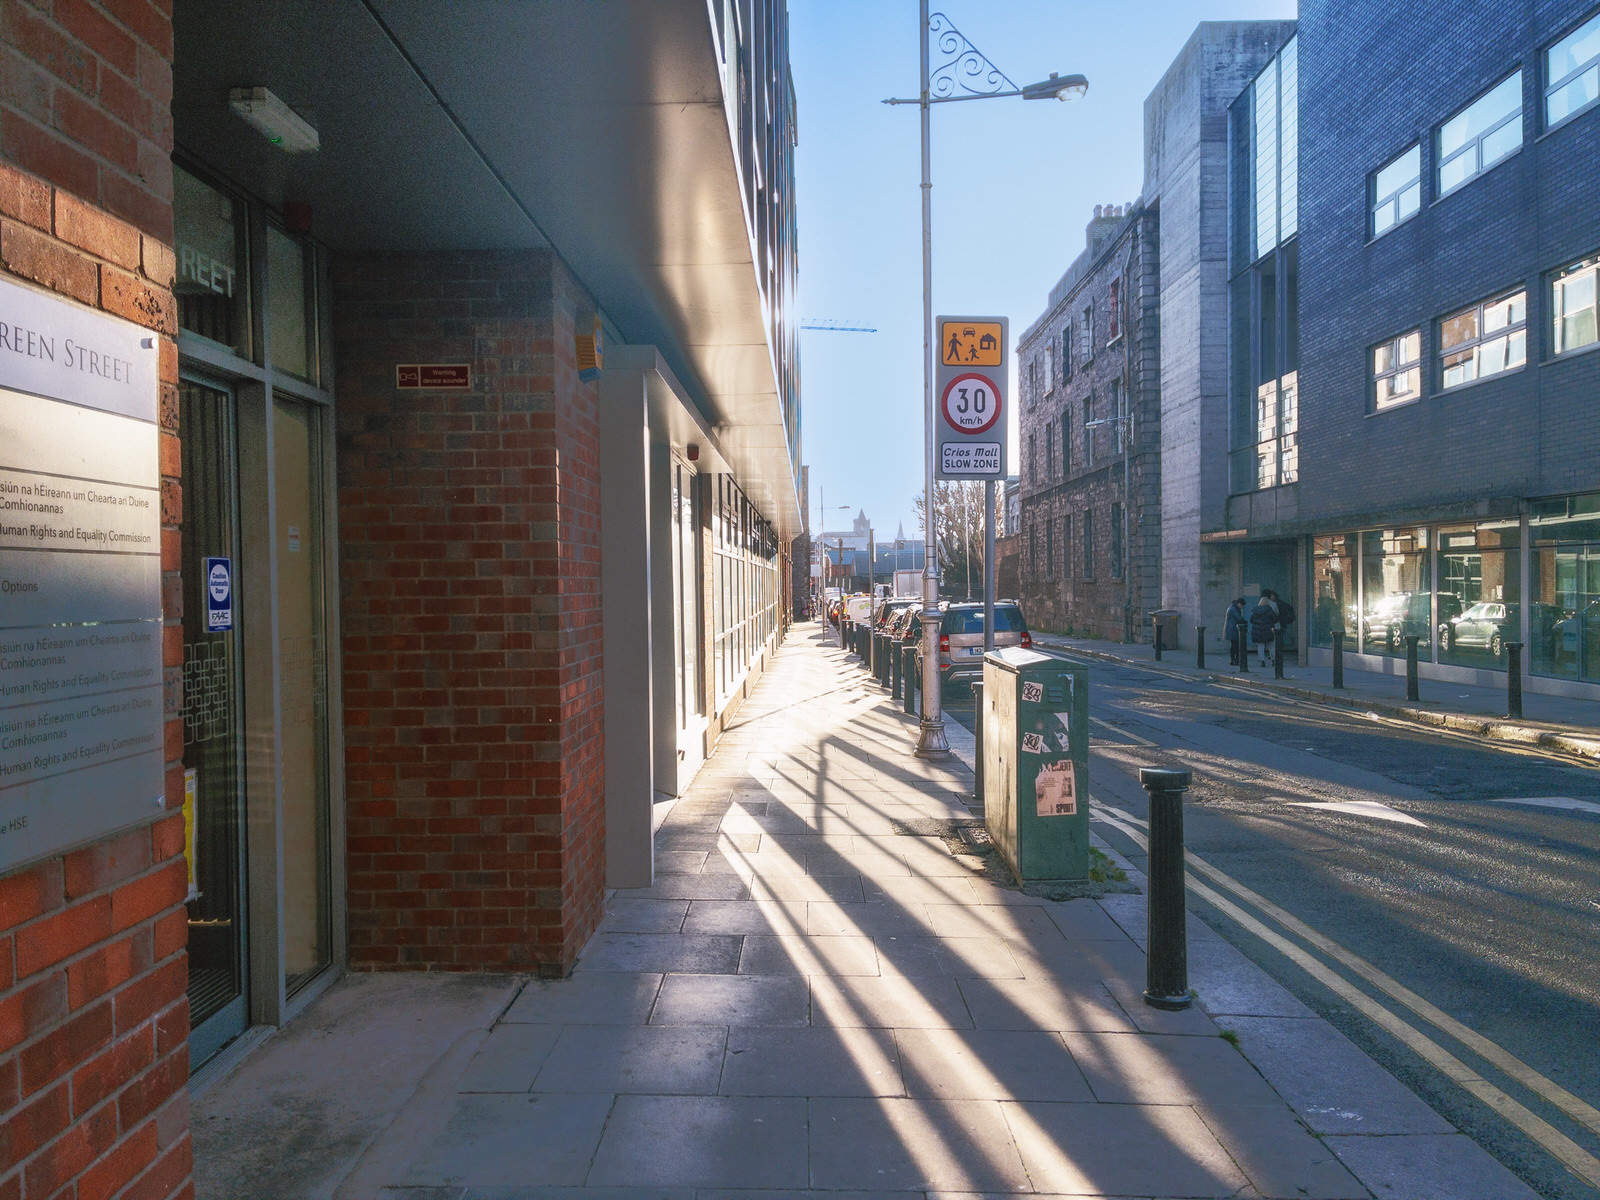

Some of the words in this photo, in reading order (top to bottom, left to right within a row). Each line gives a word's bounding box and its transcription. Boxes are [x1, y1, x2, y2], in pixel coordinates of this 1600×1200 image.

[0, 321, 55, 363] REEN
[957, 388, 986, 414] 30
[959, 416, 983, 425] km/h
[943, 447, 970, 457] Crios
[974, 447, 998, 457] Mall
[944, 459, 971, 468] SLOW
[973, 459, 999, 468] ZONE
[21, 486, 32, 495] na
[34, 482, 71, 499] hÉireann
[73, 492, 86, 501] um
[87, 490, 117, 505] Chearta
[118, 497, 127, 505] an
[128, 496, 150, 509] Duine
[0, 497, 64, 515] Comhionannas
[0, 523, 28, 536] uman
[30, 524, 57, 541] Rights
[58, 526, 74, 539] and
[76, 527, 108, 544] Equality
[108, 530, 152, 544] Commission
[1, 580, 39, 594] Options
[23, 641, 35, 651] na
[75, 638, 88, 647] um
[89, 634, 119, 646] Chearta
[130, 632, 152, 643] Duine
[0, 655, 66, 671] Comhionannas
[32, 677, 60, 694] Rights
[61, 674, 77, 688] and
[78, 672, 110, 686] Equality
[110, 667, 154, 682] Commission
[24, 719, 36, 729] na
[76, 710, 89, 720] um
[90, 702, 120, 718] Chearta
[131, 696, 153, 710] Duine
[1, 729, 67, 750] Comhionannas
[33, 754, 61, 770] Rights
[62, 748, 78, 762] and
[79, 741, 111, 758] Equality
[111, 732, 155, 751] Commission
[9, 815, 28, 832] HSE
